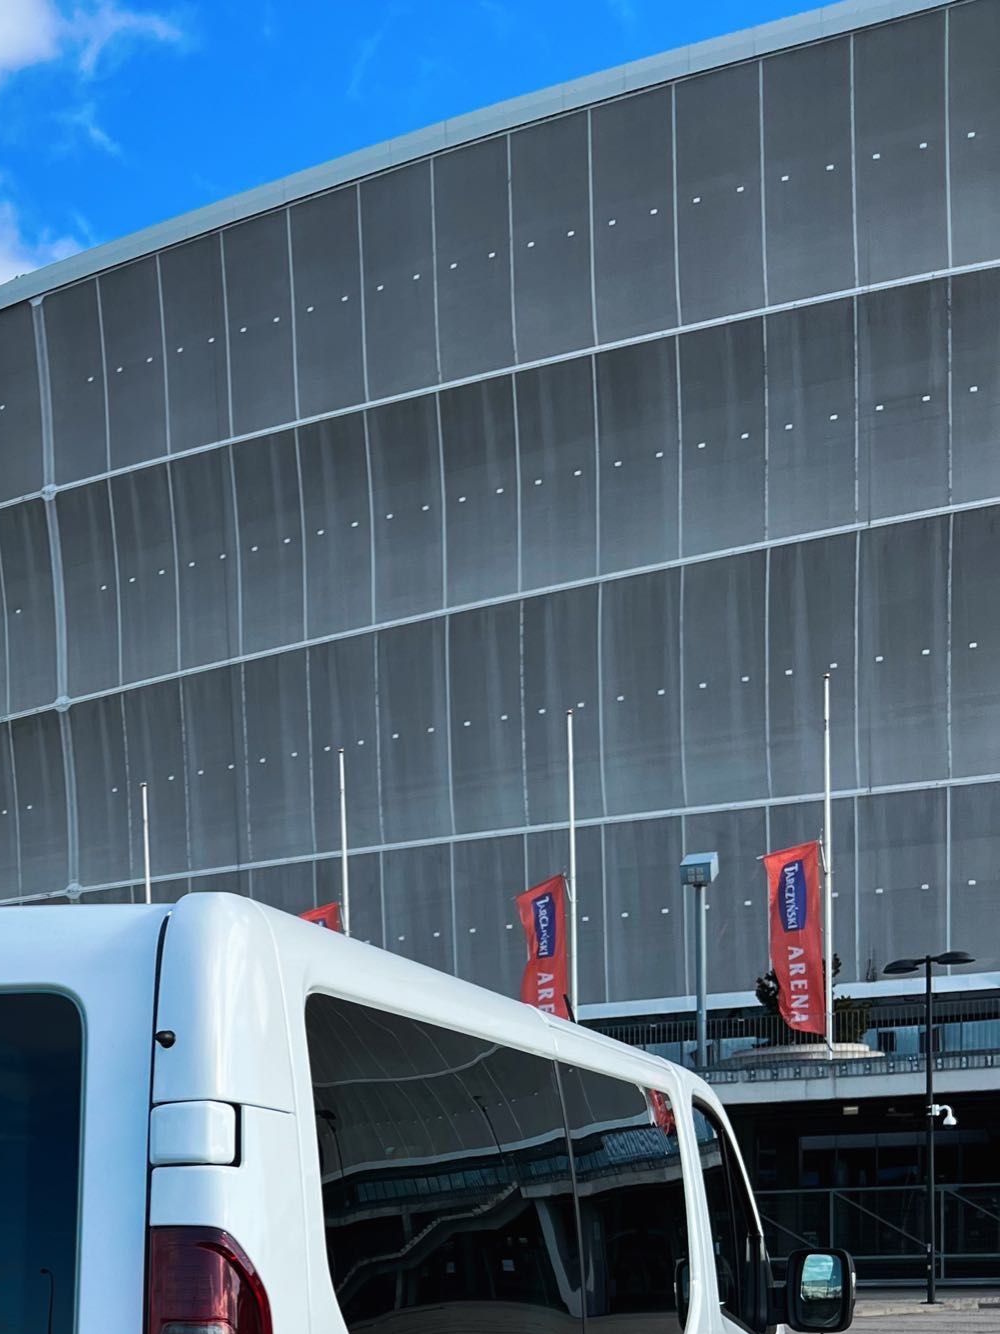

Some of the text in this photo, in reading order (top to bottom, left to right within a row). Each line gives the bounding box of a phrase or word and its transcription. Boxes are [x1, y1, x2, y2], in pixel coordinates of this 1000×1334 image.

[784, 863, 799, 930] TARCZYŃSKI
[536, 971, 556, 1014] ARE
[787, 945, 809, 1024] ARENA
